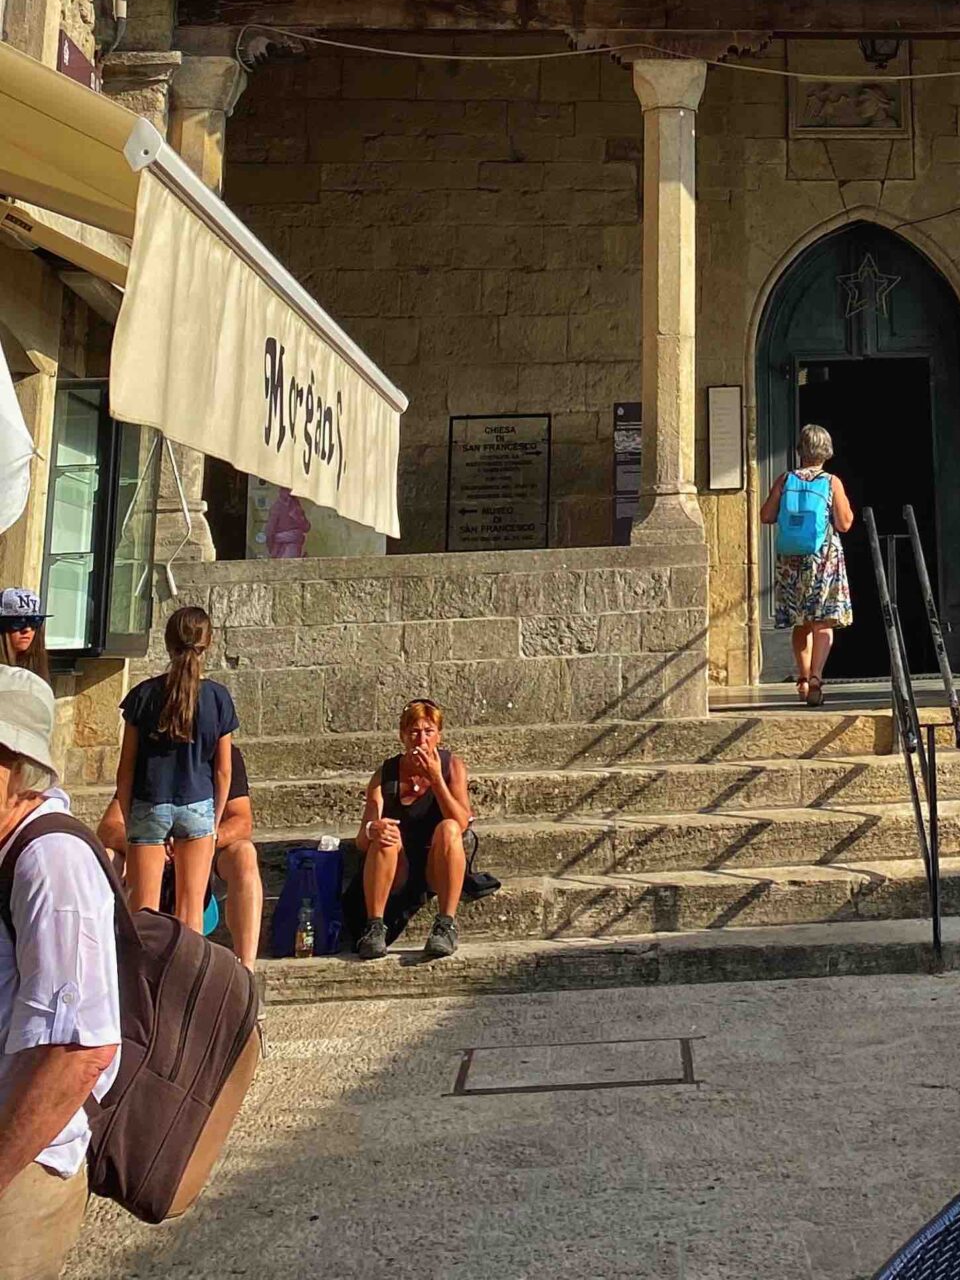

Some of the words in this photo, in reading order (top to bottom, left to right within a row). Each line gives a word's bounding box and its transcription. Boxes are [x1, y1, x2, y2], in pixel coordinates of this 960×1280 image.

[484, 426, 517, 434] CHIESA
[463, 444, 480, 452] SAN
[483, 442, 537, 452] FRANCESCO
[493, 515, 502, 523] DI
[459, 524, 478, 534] SAN
[480, 523, 535, 533] FRANCESCO
[17, 594, 38, 612] NY
